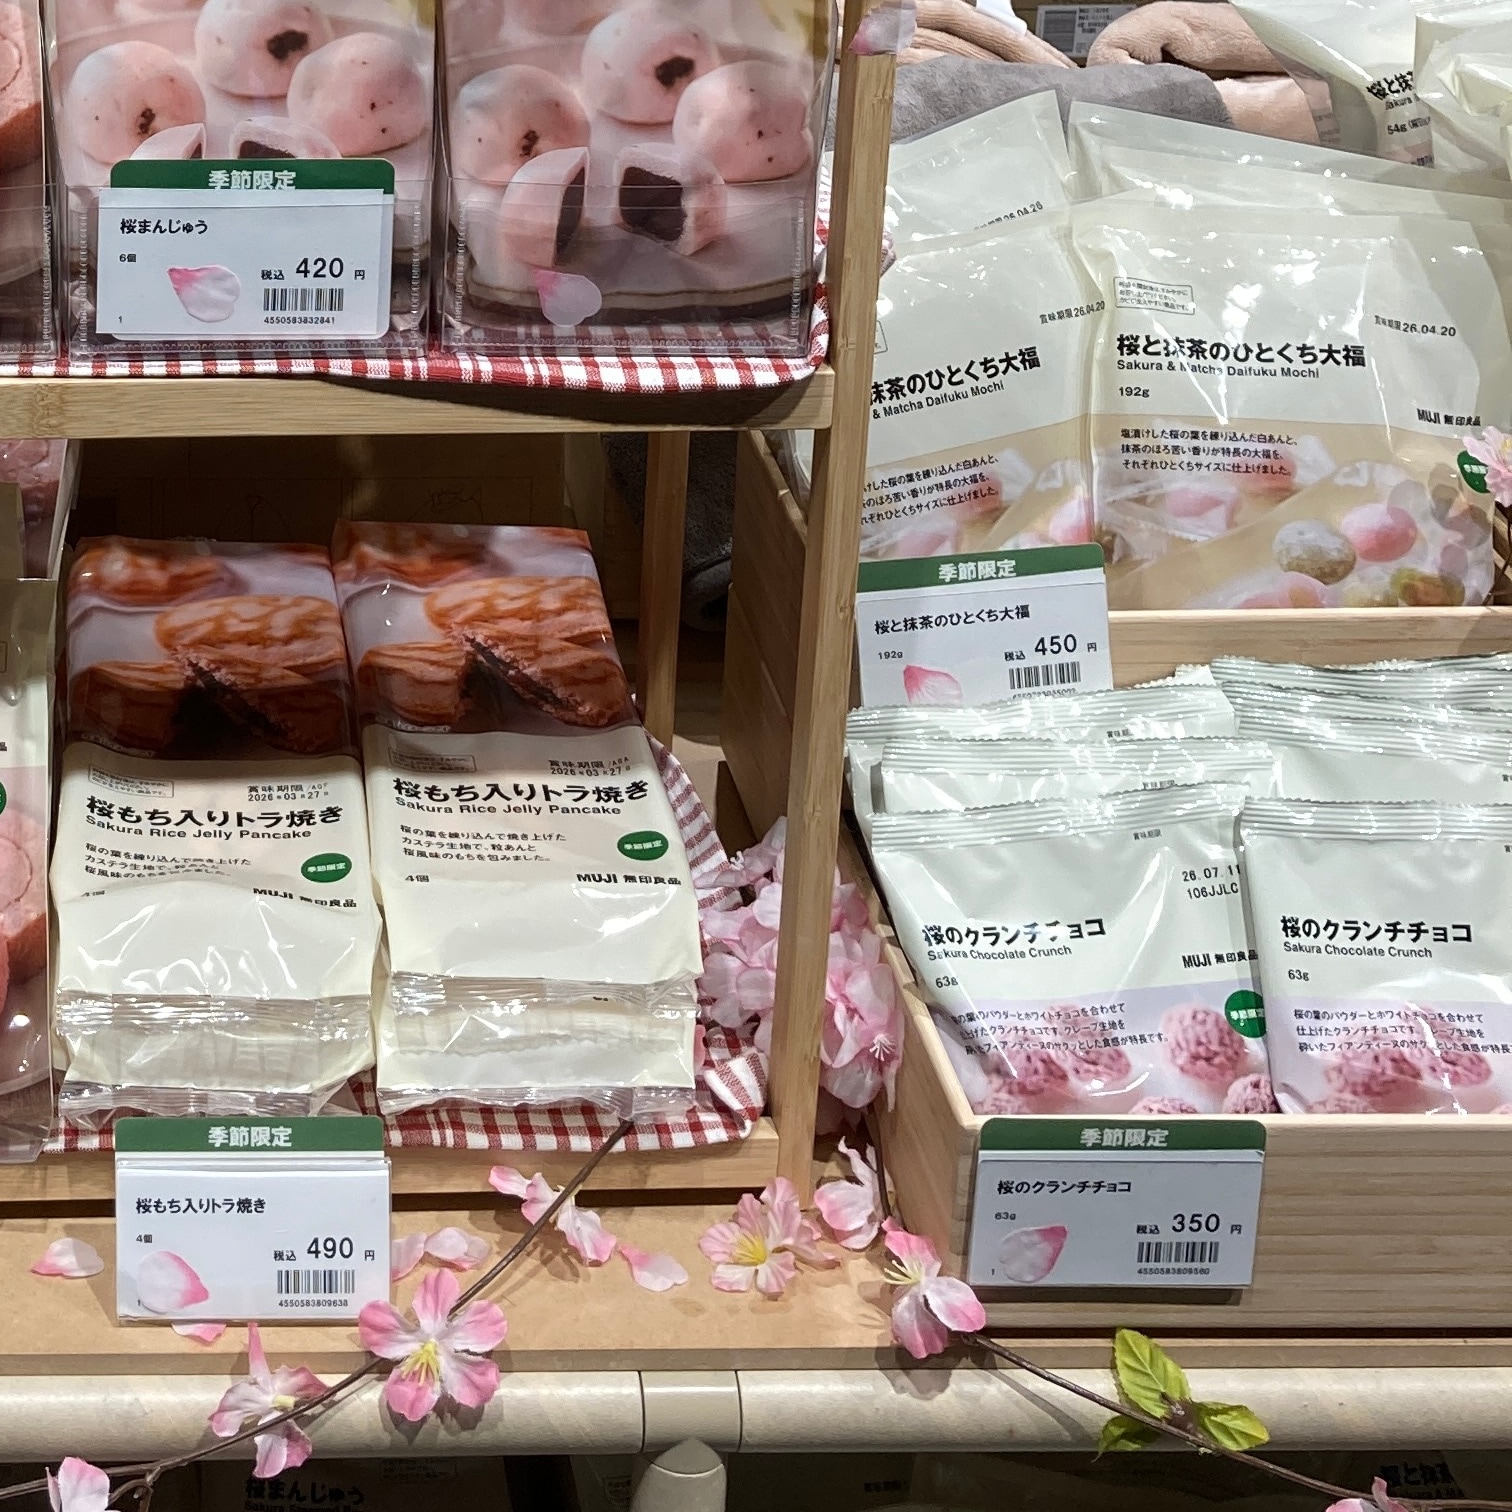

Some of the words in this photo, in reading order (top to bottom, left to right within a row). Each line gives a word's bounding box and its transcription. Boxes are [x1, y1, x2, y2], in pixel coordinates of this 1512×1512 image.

[120, 218, 209, 235] 桜まんじゅう
[261, 269, 285, 281] 税込
[295, 257, 344, 278] 420
[354, 269, 365, 280] 円
[264, 316, 335, 325] 4550583832841
[1117, 359, 1163, 371] Sakura
[1167, 361, 1176, 371] &
[1227, 365, 1277, 378] Daifuku
[1281, 366, 1319, 379] Mochi
[872, 409, 881, 420] &
[883, 396, 924, 418] Matcha
[926, 389, 969, 408] Daifuku
[971, 380, 1004, 397] Mochi
[1118, 387, 1150, 399] 192g
[1120, 428, 1299, 446] 塩漬けした桜の葉を練り込んだ白あんと、
[1120, 444, 1284, 460] 抹茶のほろ苦い香りが特長の大福を、
[875, 604, 1030, 635] 桜と抹茶のひとくち大福
[878, 650, 903, 660] 192g
[1004, 650, 1026, 661] 税込
[1034, 633, 1078, 656] 450
[1087, 642, 1098, 653] 円
[392, 777, 648, 804] 桜もち入りトラ焼き
[87, 795, 344, 828] 桜もち入りトラ焼き
[395, 796, 453, 814] Sakura
[459, 805, 497, 814] Rice
[503, 805, 542, 816] Jelly
[549, 805, 621, 815] Pancake
[86, 814, 143, 837] Sakura
[149, 828, 187, 838] Rice
[193, 829, 233, 841] Jelly
[239, 829, 312, 839] Pancake
[400, 825, 566, 842] 桜の葉を練り込んで焼き上げた
[1281, 915, 1473, 943] 桜のクランチチョコ
[969, 947, 1026, 961] Chocolate
[1029, 945, 1072, 958] Crunch
[1283, 942, 1322, 955] Sakura
[1325, 945, 1385, 957] Chocolate
[1388, 947, 1433, 959] Crunch
[1288, 970, 1309, 981] 63g
[208, 1126, 292, 1147] 季節限定
[1080, 1128, 1169, 1147] 季節限定
[997, 1180, 1132, 1195] 桜のクランチチョコ
[136, 1197, 266, 1214] 桜もち入りトラ焼き
[1136, 1224, 1160, 1235] 税込
[1171, 1213, 1221, 1233] 350
[1231, 1224, 1242, 1234] 円
[136, 1234, 153, 1244] 4個
[273, 1250, 296, 1261] 税込
[306, 1237, 353, 1259] 490
[364, 1250, 375, 1261] 円
[278, 1299, 348, 1307] 4550583809638
